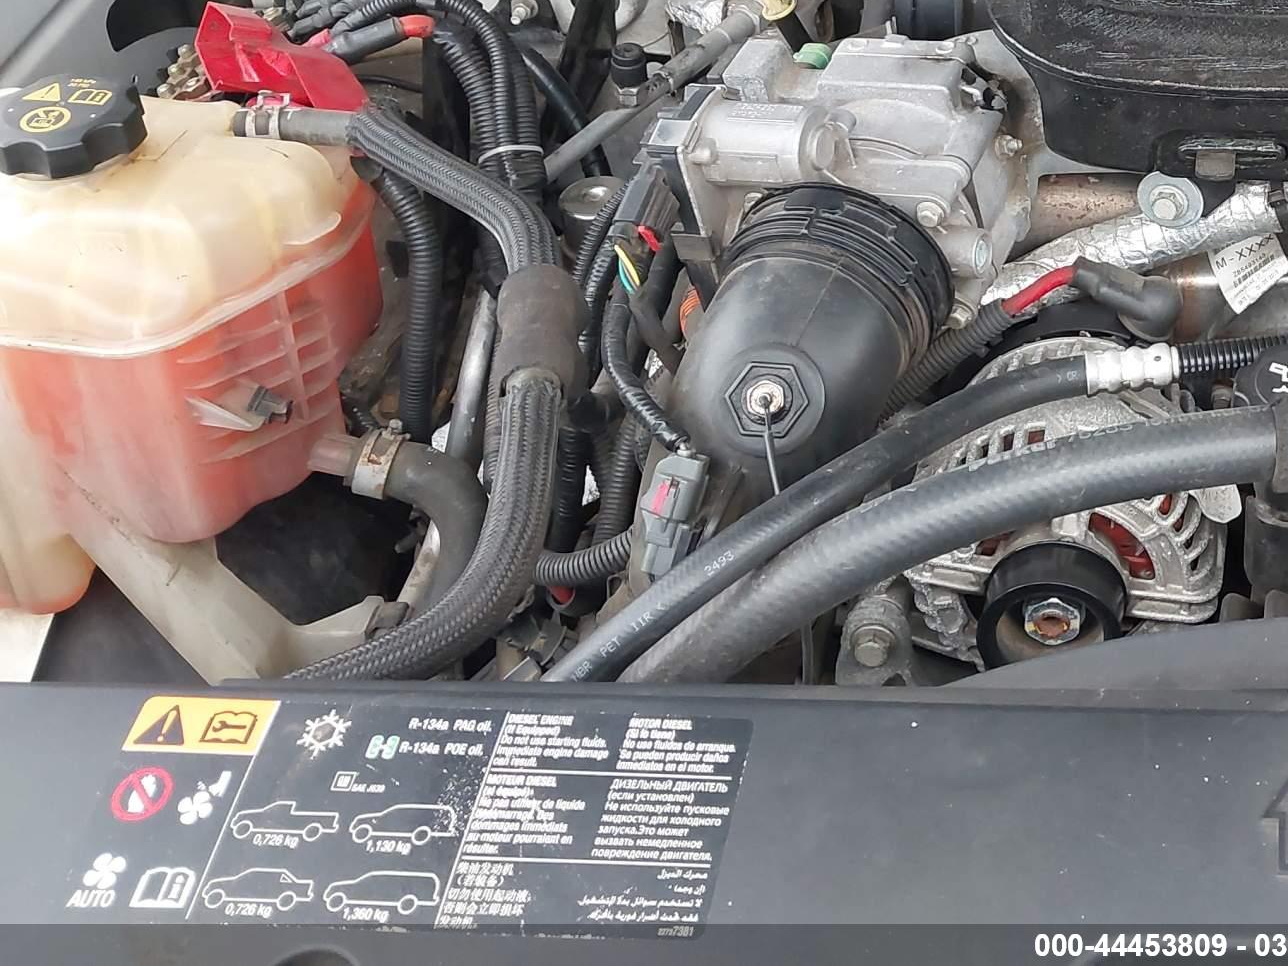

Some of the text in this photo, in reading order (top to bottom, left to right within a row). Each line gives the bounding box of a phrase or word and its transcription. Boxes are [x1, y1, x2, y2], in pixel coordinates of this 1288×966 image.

[600, 635, 623, 658] PET
[704, 550, 735, 577] 2493
[409, 718, 449, 731] R-134a
[477, 720, 492, 732] oil.
[508, 714, 574, 726] DIESEL ENGINE
[629, 718, 692, 730] MOTOR DIESEL
[501, 735, 513, 744] Do
[513, 736, 529, 745] not
[529, 737, 546, 745] use
[547, 737, 580, 748] starting
[622, 739, 635, 748] No
[684, 741, 695, 751] de
[399, 741, 483, 756] R-134a POE oil.
[543, 748, 574, 759] engine
[574, 748, 609, 760] damage
[619, 749, 632, 759] Se
[632, 750, 665, 761] pueden
[665, 752, 702, 762] producir
[664, 763, 676, 771] en
[677, 762, 686, 772] el
[610, 778, 728, 793] ДИЗЕЛЬНЫЙ ДВИГАТЕЛЬ
[607, 791, 695, 803] (если установлен)
[542, 799, 555, 809] de
[555, 799, 585, 811] liquide
[605, 801, 730, 815] Не используйте пусковые
[601, 814, 722, 826] жидкости для холодного
[657, 828, 689, 837] может
[253, 834, 299, 848] 0,726 kg
[560, 835, 573, 844] en
[594, 837, 703, 849] вызвать немедленное
[365, 840, 411, 855] 1,130 kg
[591, 849, 659, 859] повреждение
[65, 890, 116, 908] AUTO
[225, 903, 272, 917] 0,726 kg
[343, 908, 389, 923] 1,360 kg
